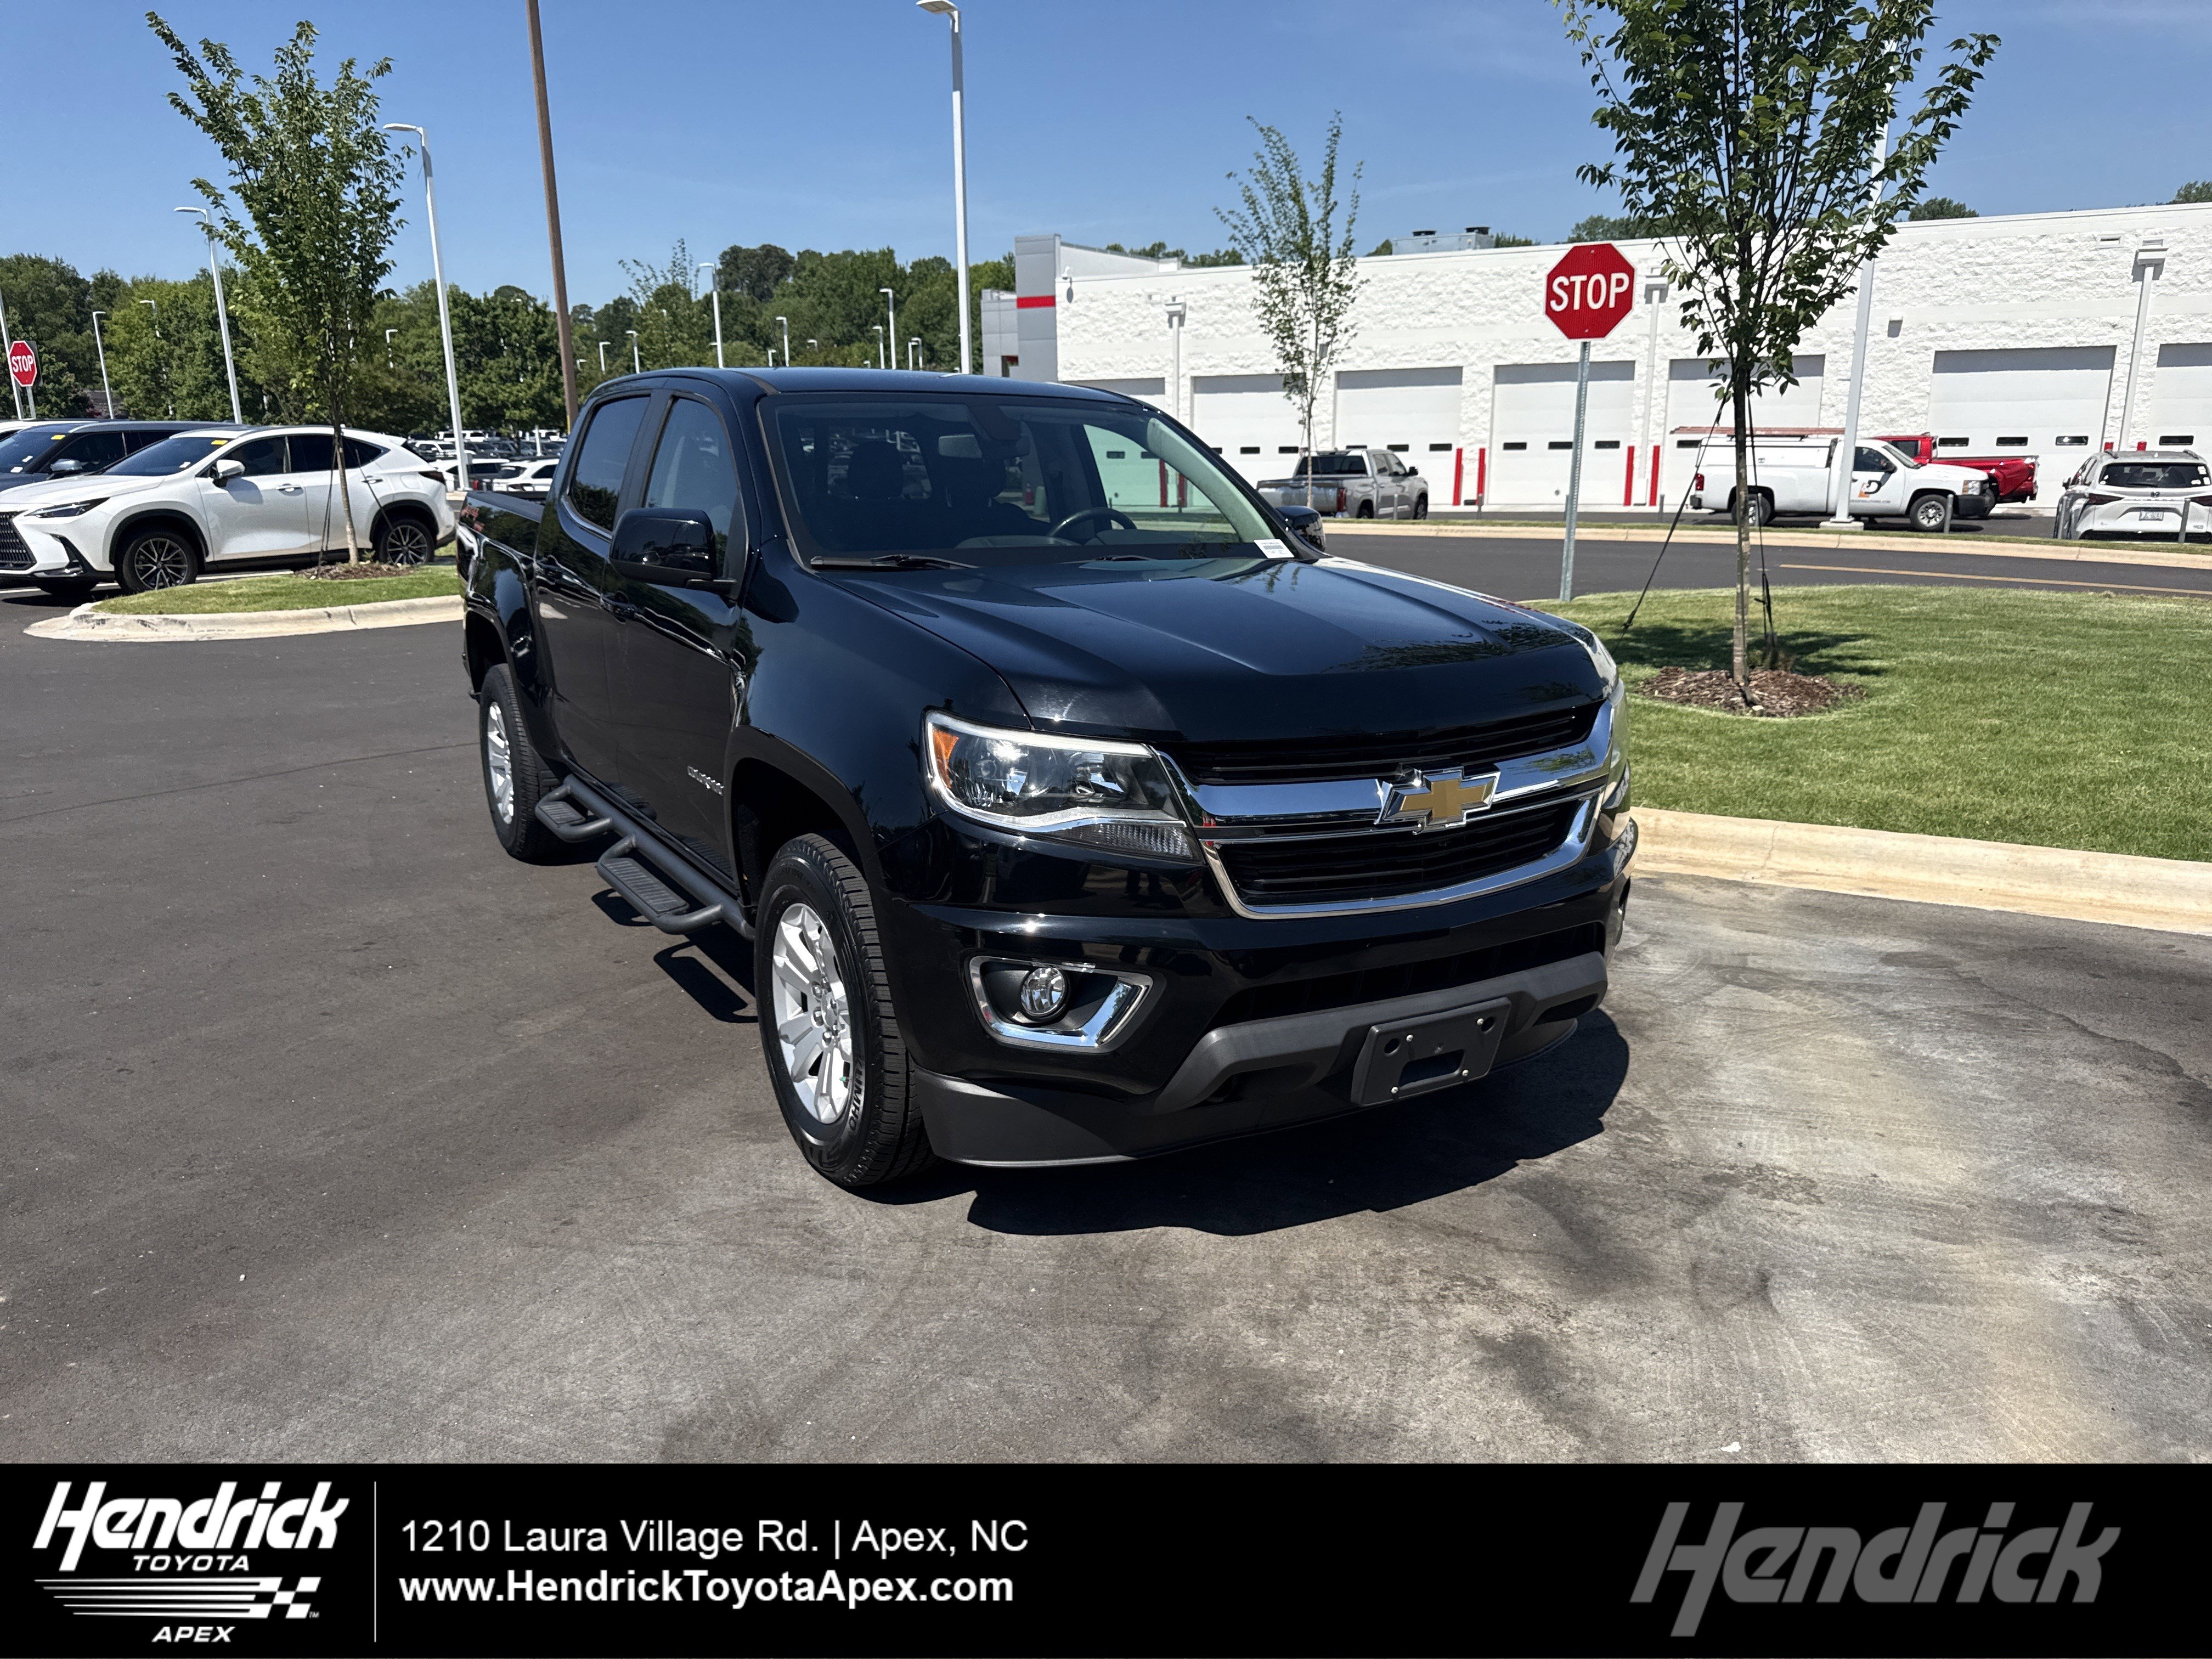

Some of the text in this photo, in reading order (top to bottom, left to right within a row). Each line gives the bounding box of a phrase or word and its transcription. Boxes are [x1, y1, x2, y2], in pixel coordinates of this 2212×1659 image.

[1550, 272, 1629, 312] STOP
[12, 355, 33, 373] STOP
[849, 1052, 863, 1131] KUMHO
